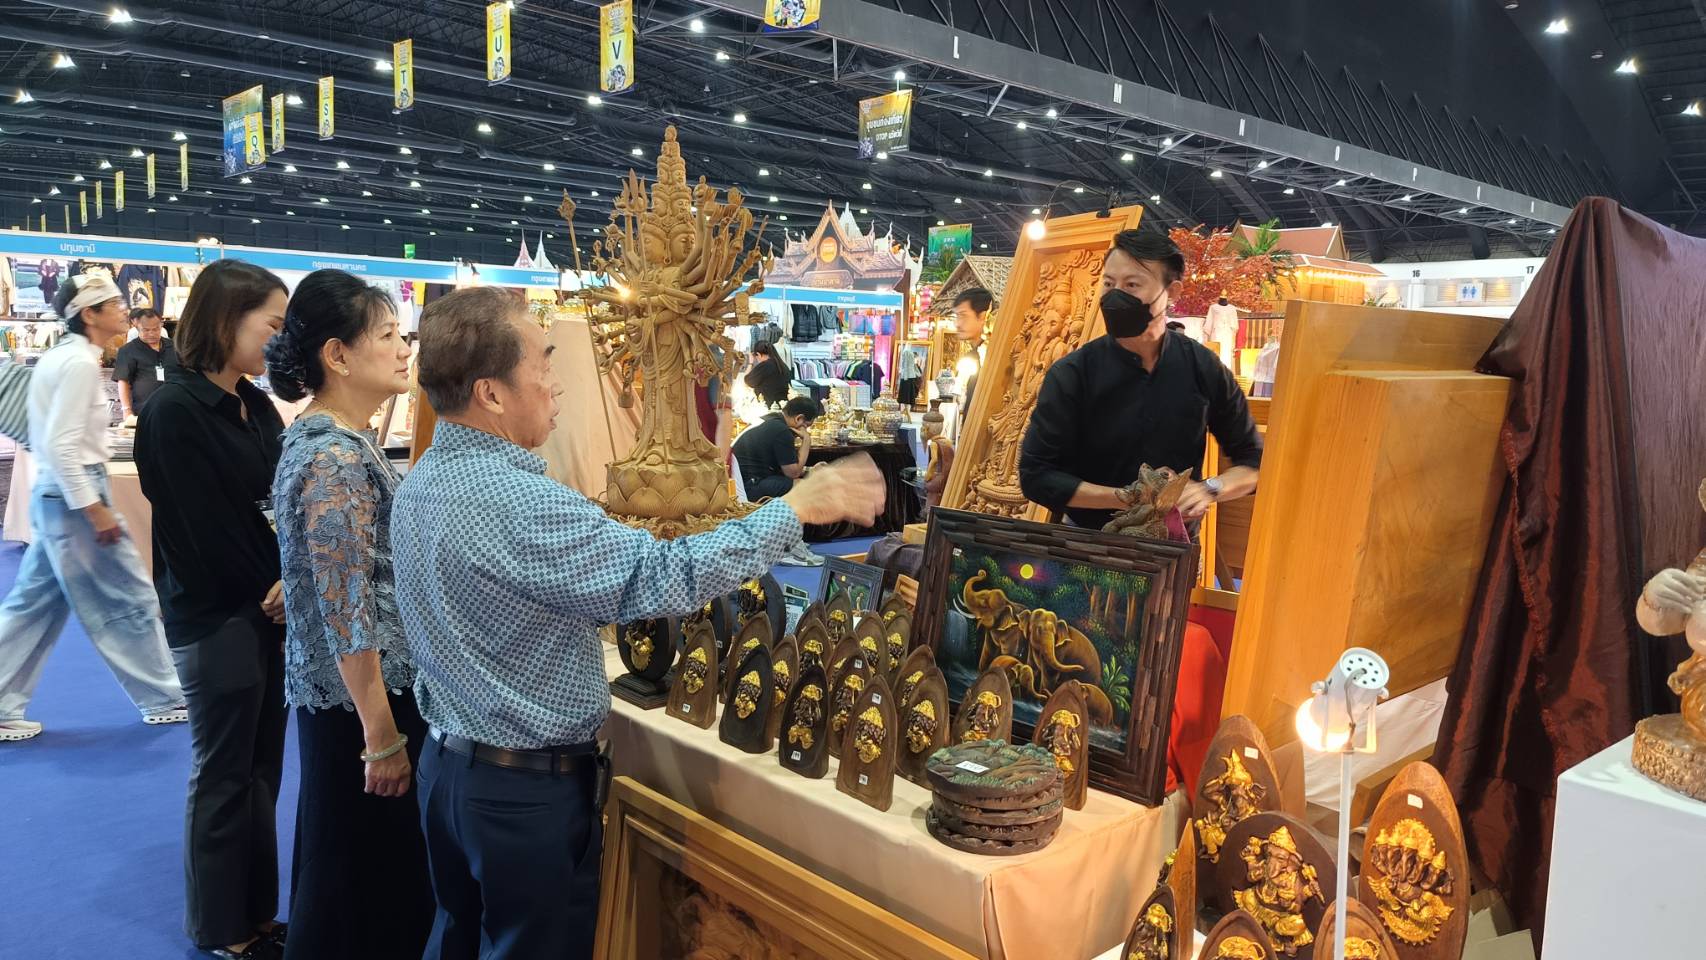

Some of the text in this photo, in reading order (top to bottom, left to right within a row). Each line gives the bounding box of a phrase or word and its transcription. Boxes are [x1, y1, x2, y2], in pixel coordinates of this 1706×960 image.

[495, 35, 502, 52] U
[612, 40, 621, 60] V
[401, 70, 406, 84] T
[323, 103, 329, 116] S
[275, 118, 280, 131] R
[251, 135, 258, 149] Q
[60, 243, 96, 255] ปทุมธานี
[1412, 265, 1534, 278] 16 17
